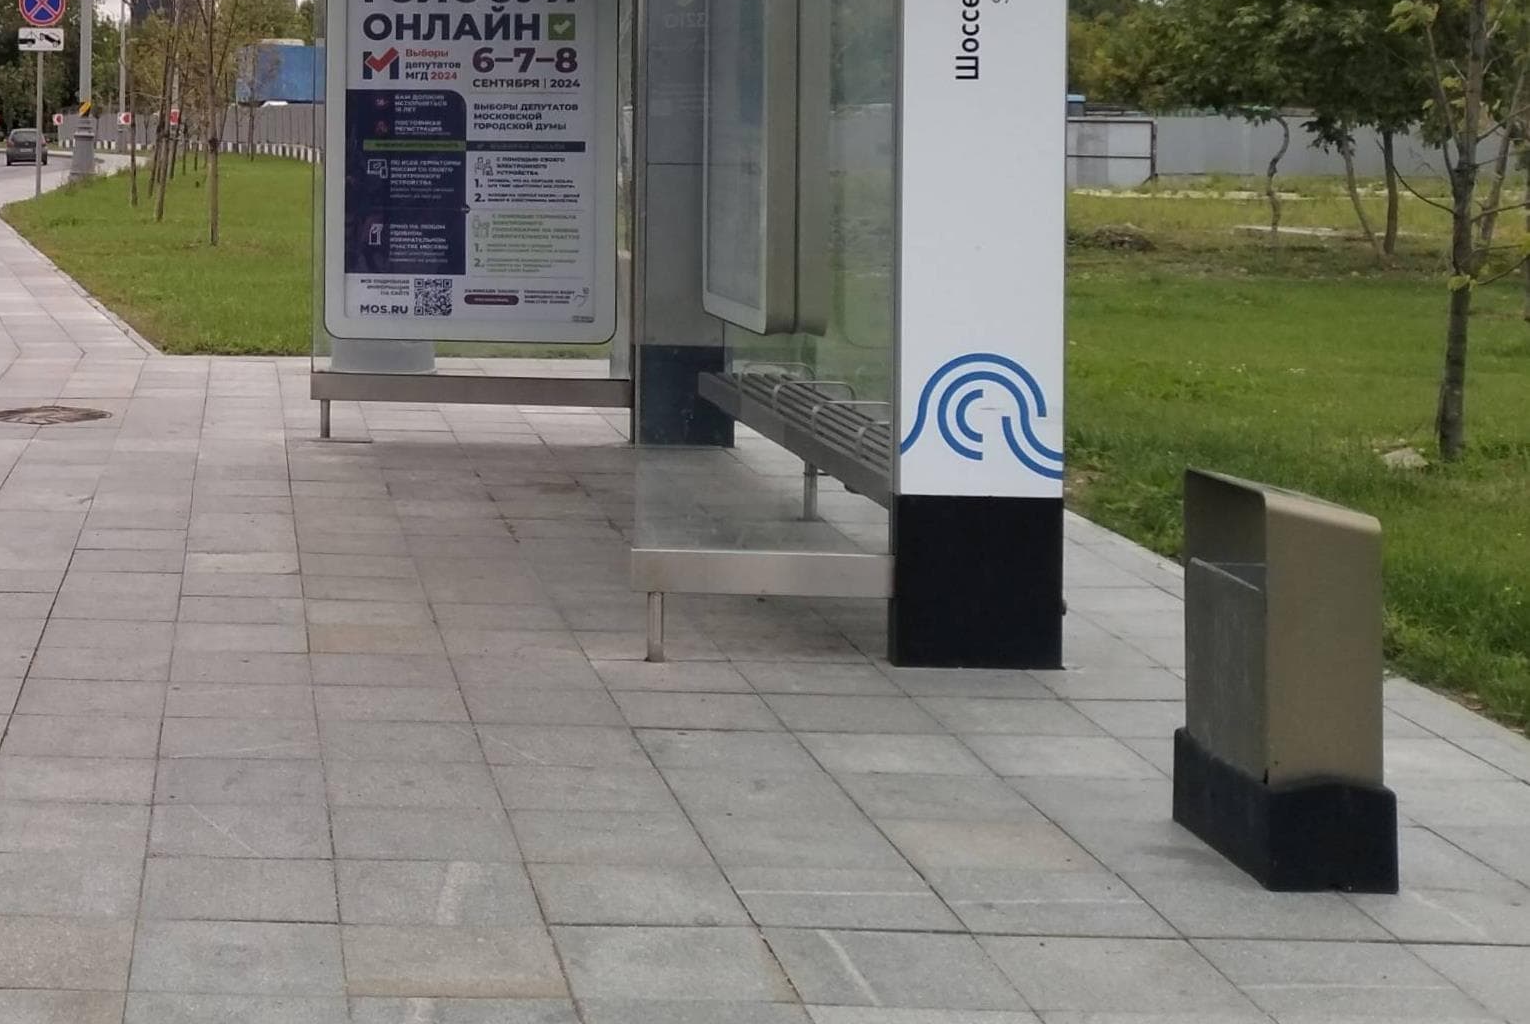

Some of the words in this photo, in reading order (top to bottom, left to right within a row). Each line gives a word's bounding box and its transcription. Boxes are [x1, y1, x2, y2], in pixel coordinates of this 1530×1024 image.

[362, 5, 540, 41] ОНЛАЙН
[405, 48, 449, 58] Выборы
[405, 61, 461, 71] депутатов
[405, 72, 429, 81] МГД
[430, 71, 458, 81] 2024
[472, 79, 540, 88] СЕНТЯБРЯ
[550, 79, 581, 89] 2024
[520, 103, 579, 111] ДЕПУТАТОВ
[474, 112, 542, 120] МОСКОВСКОЙ
[474, 122, 534, 130] ГОРОДСКОЙ
[535, 123, 567, 131] ДУМЫ
[474, 193, 486, 202] 2.
[360, 304, 409, 314] MOS.RU
